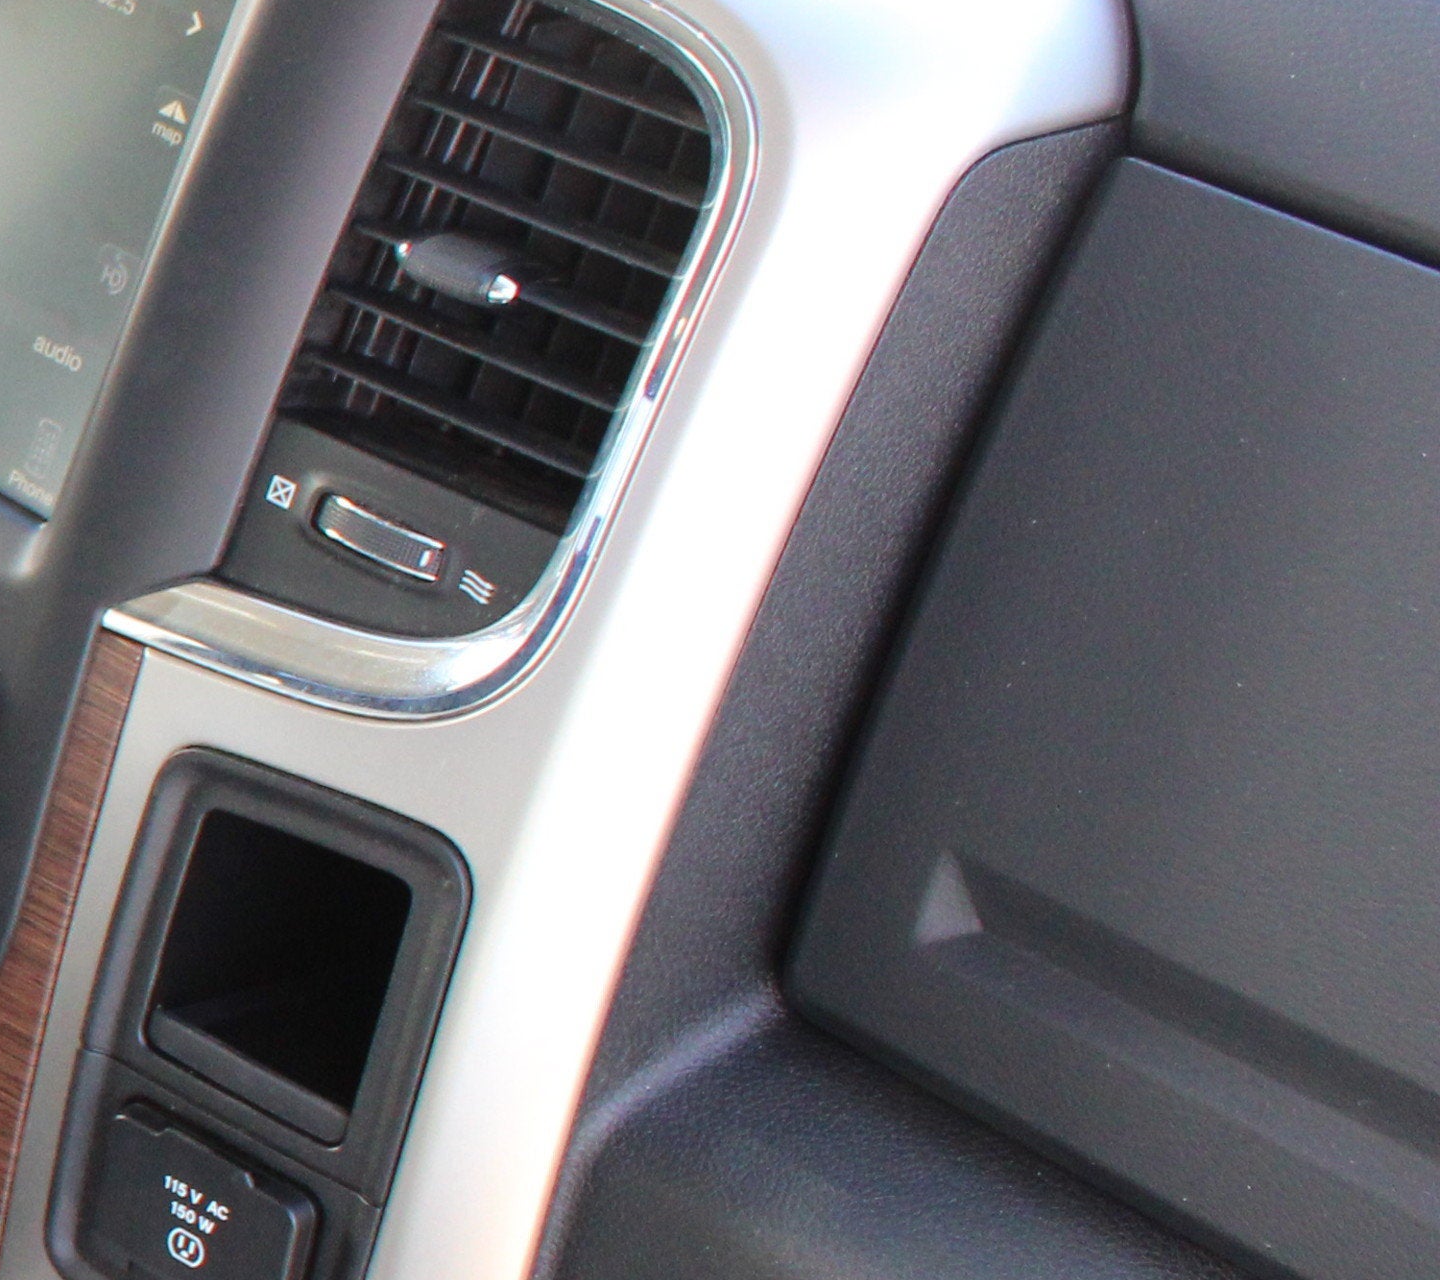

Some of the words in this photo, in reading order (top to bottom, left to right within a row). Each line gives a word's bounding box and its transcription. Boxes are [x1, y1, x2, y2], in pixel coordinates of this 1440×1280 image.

[151, 121, 184, 147] map
[33, 335, 83, 372] audio
[205, 1200, 231, 1221] AC
